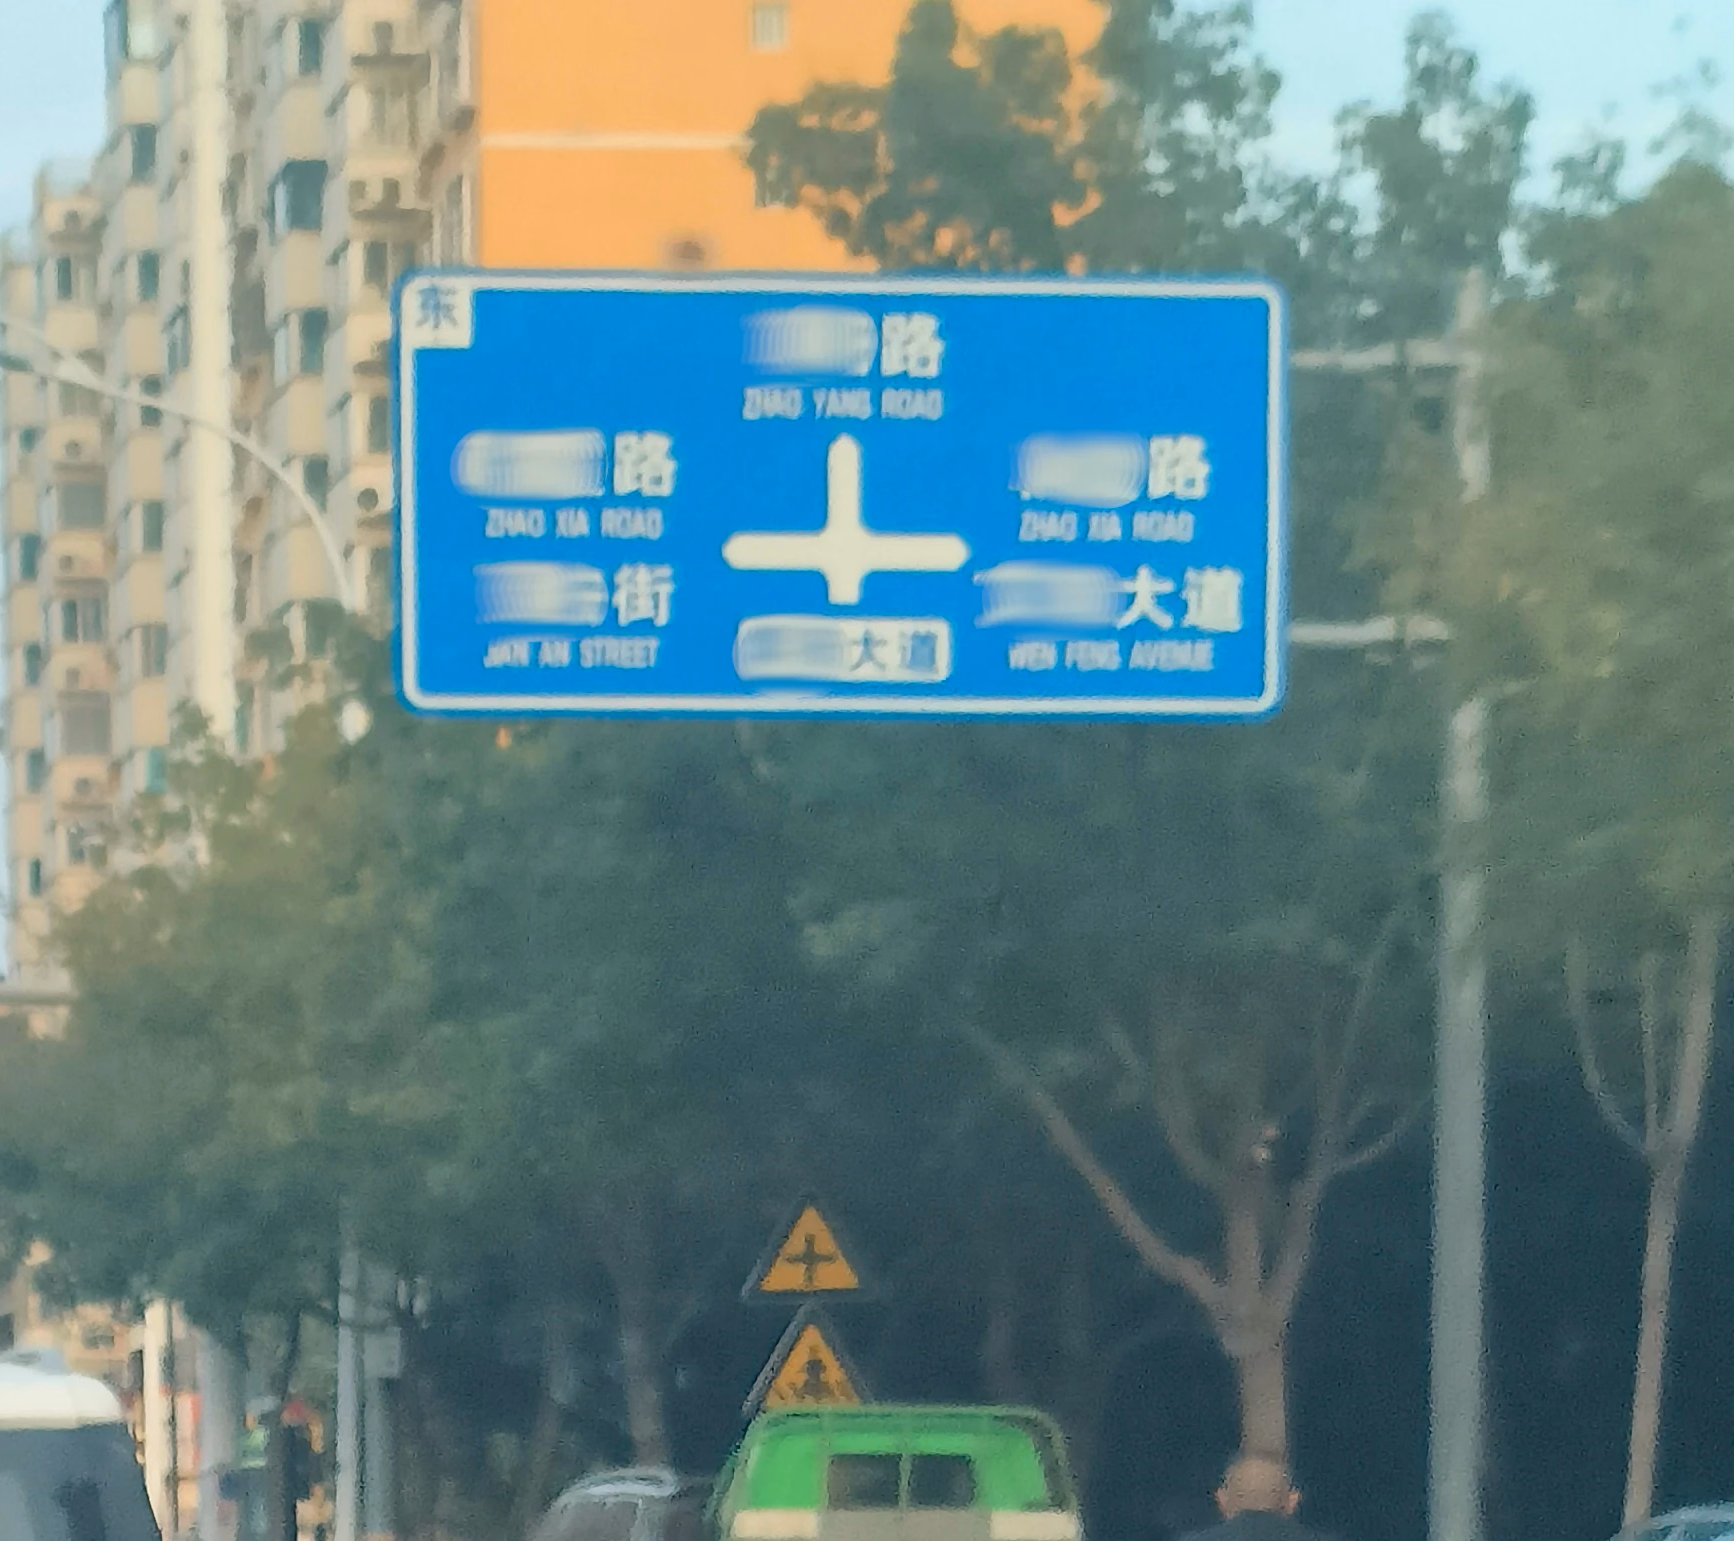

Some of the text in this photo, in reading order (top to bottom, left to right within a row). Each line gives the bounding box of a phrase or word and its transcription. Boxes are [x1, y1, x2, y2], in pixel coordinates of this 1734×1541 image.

[882, 388, 943, 420] ROAD
[601, 508, 663, 540] ROAD
[1132, 510, 1195, 543] ROAD
[579, 636, 660, 668] STREET
